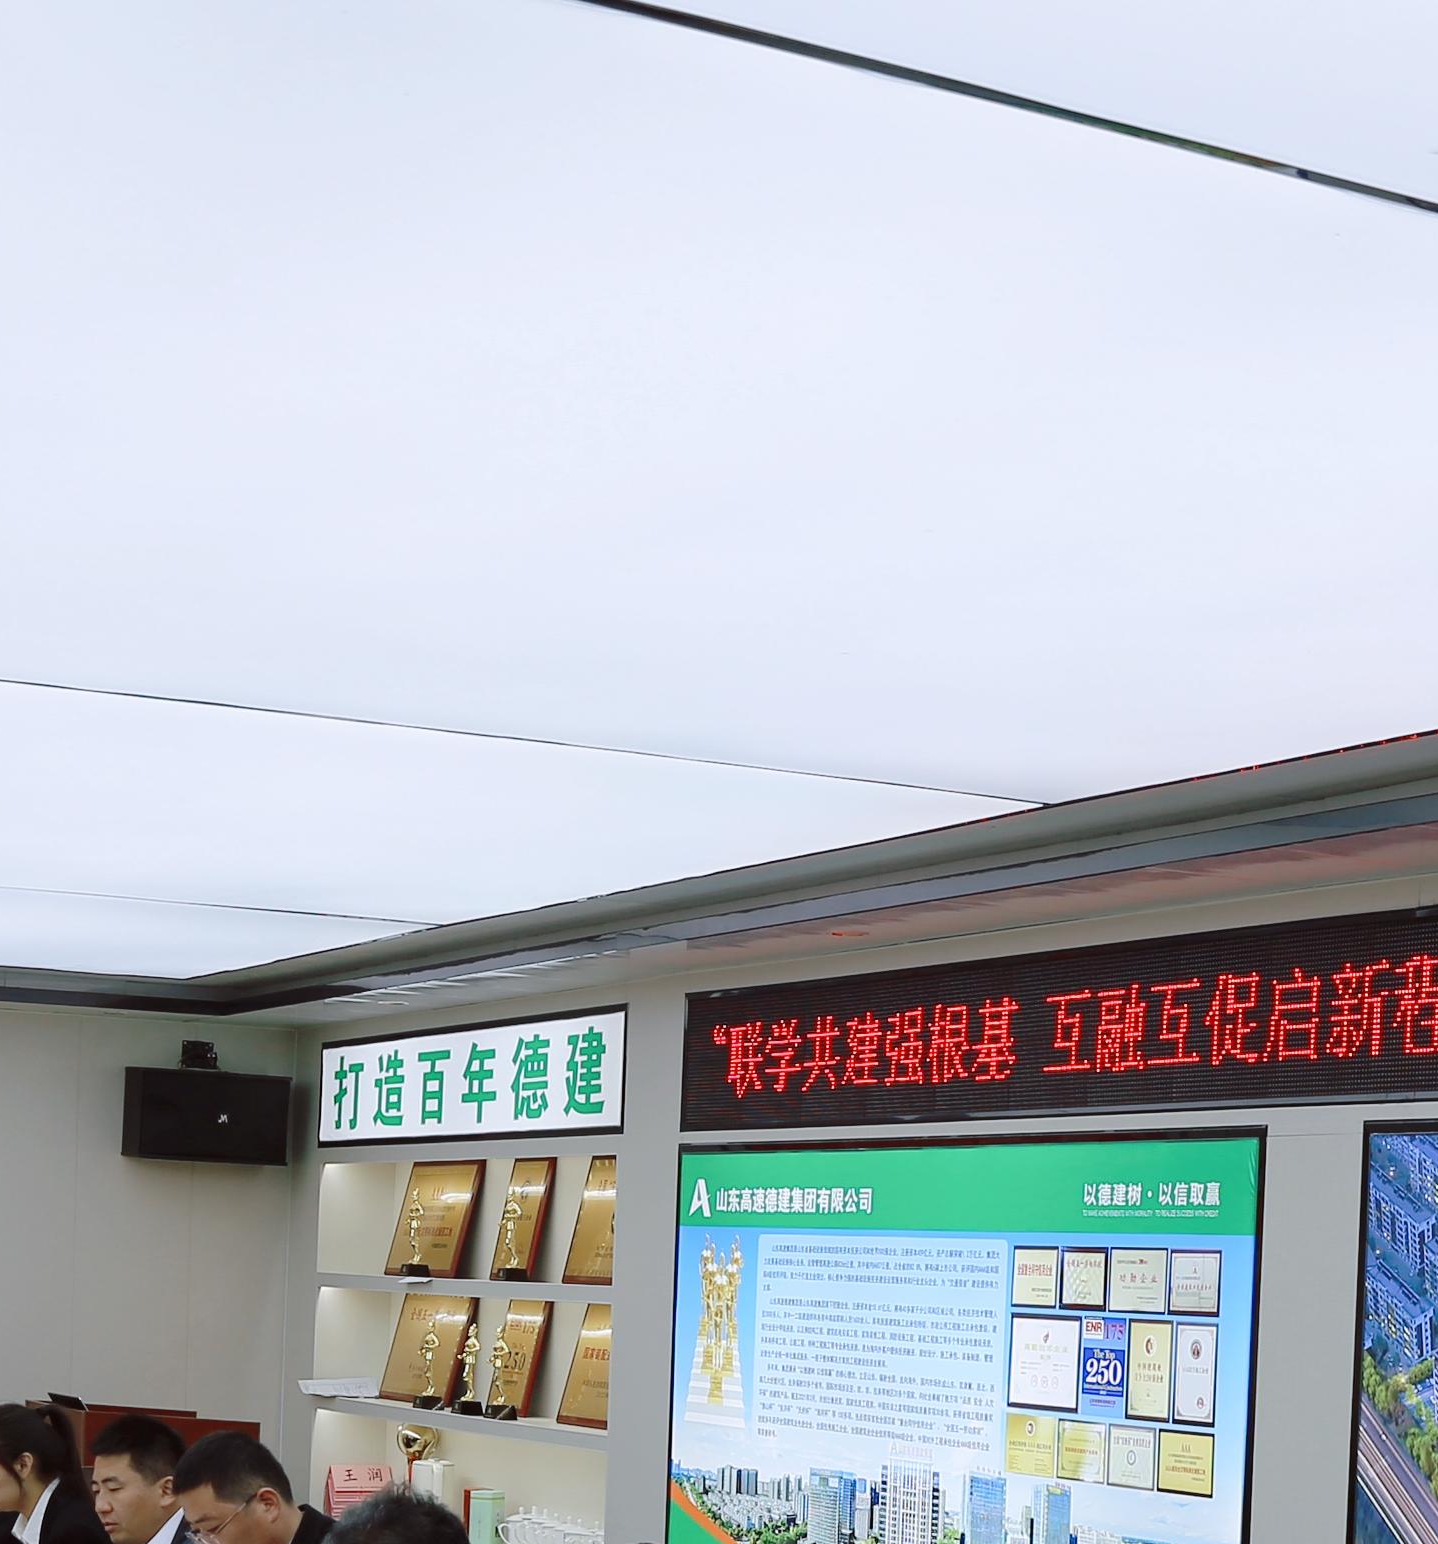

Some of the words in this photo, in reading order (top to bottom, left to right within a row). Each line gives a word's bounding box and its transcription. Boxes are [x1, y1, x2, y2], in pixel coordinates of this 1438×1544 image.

[334, 1026, 607, 1131] 打造百年德建
[716, 1187, 873, 1214] 山东高速德建集团有限公司
[1085, 1358, 1123, 1385] 250
[343, 1468, 384, 1484] 王润
